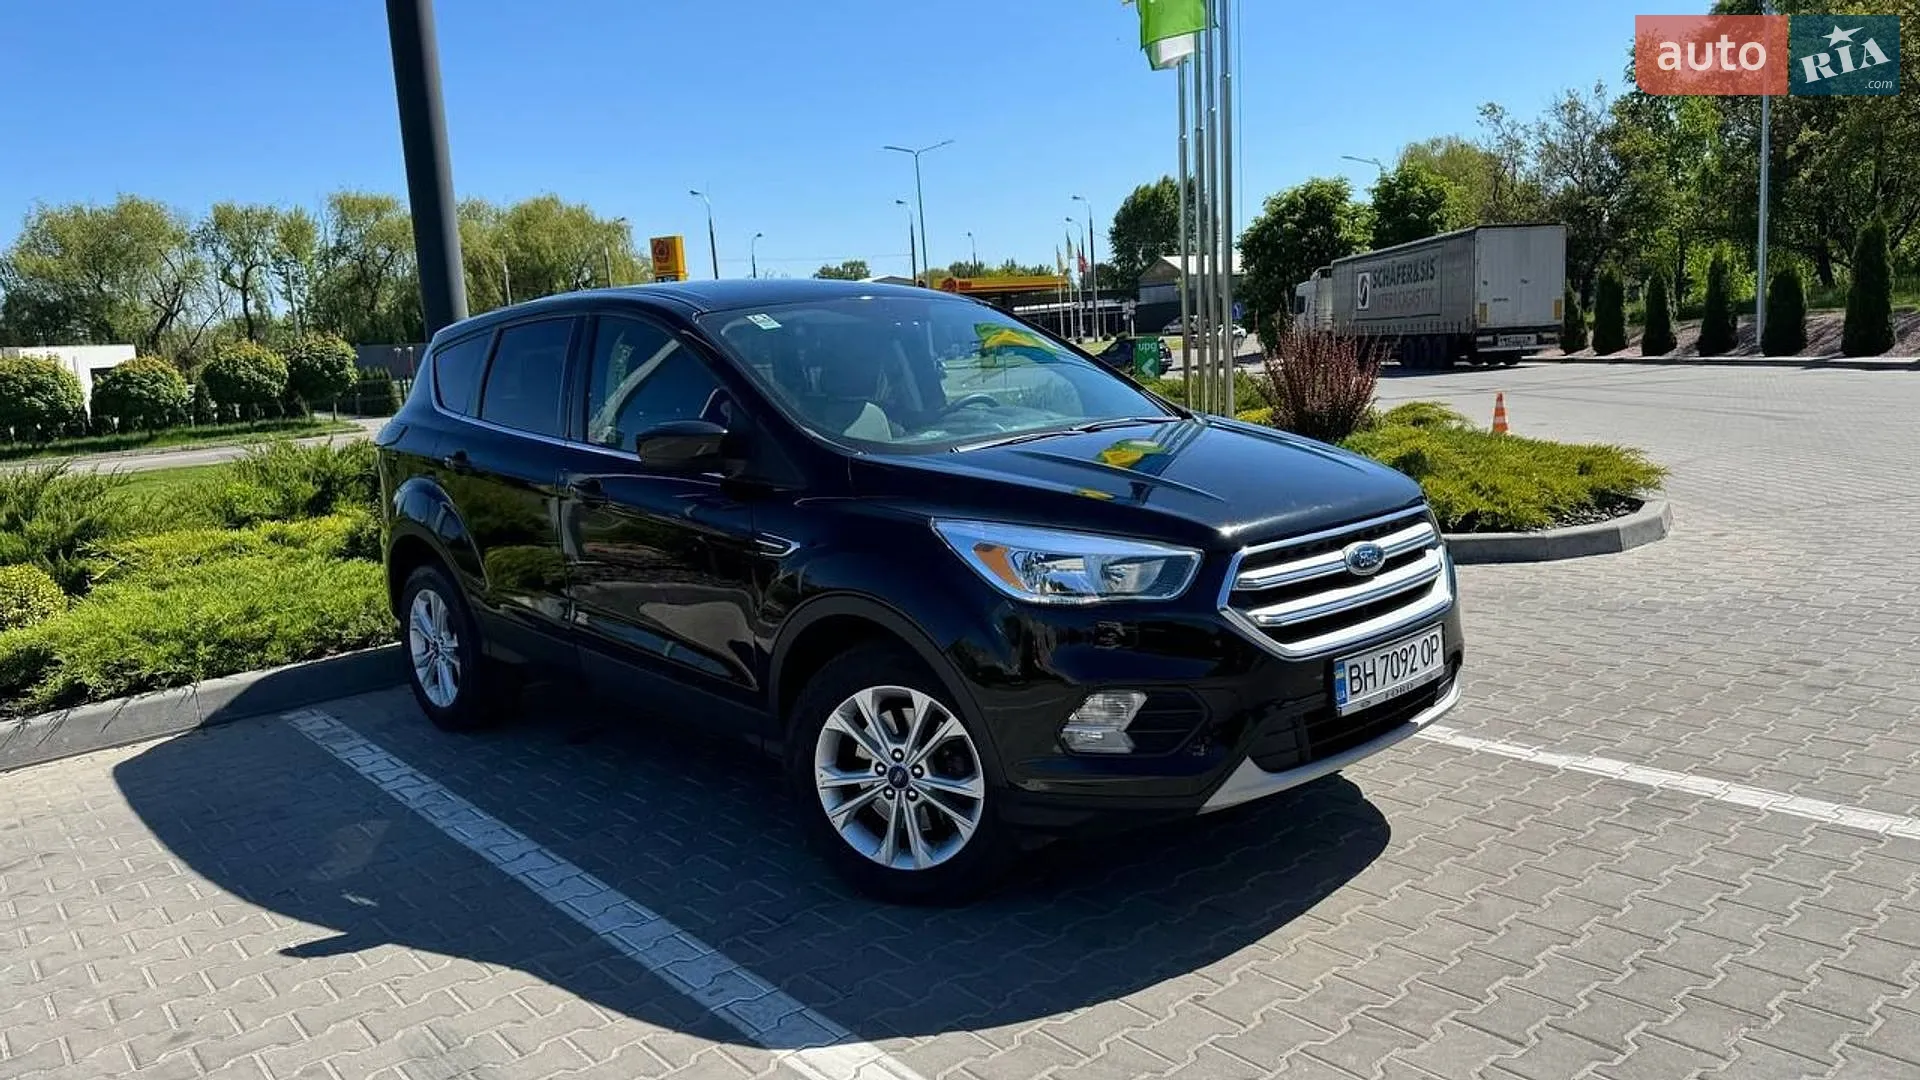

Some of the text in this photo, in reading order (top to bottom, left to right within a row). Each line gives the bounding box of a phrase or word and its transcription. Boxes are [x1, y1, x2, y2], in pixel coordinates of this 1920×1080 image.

[1138, 342, 1158, 352] upg
[1349, 634, 1440, 695] BH 7092 OP
